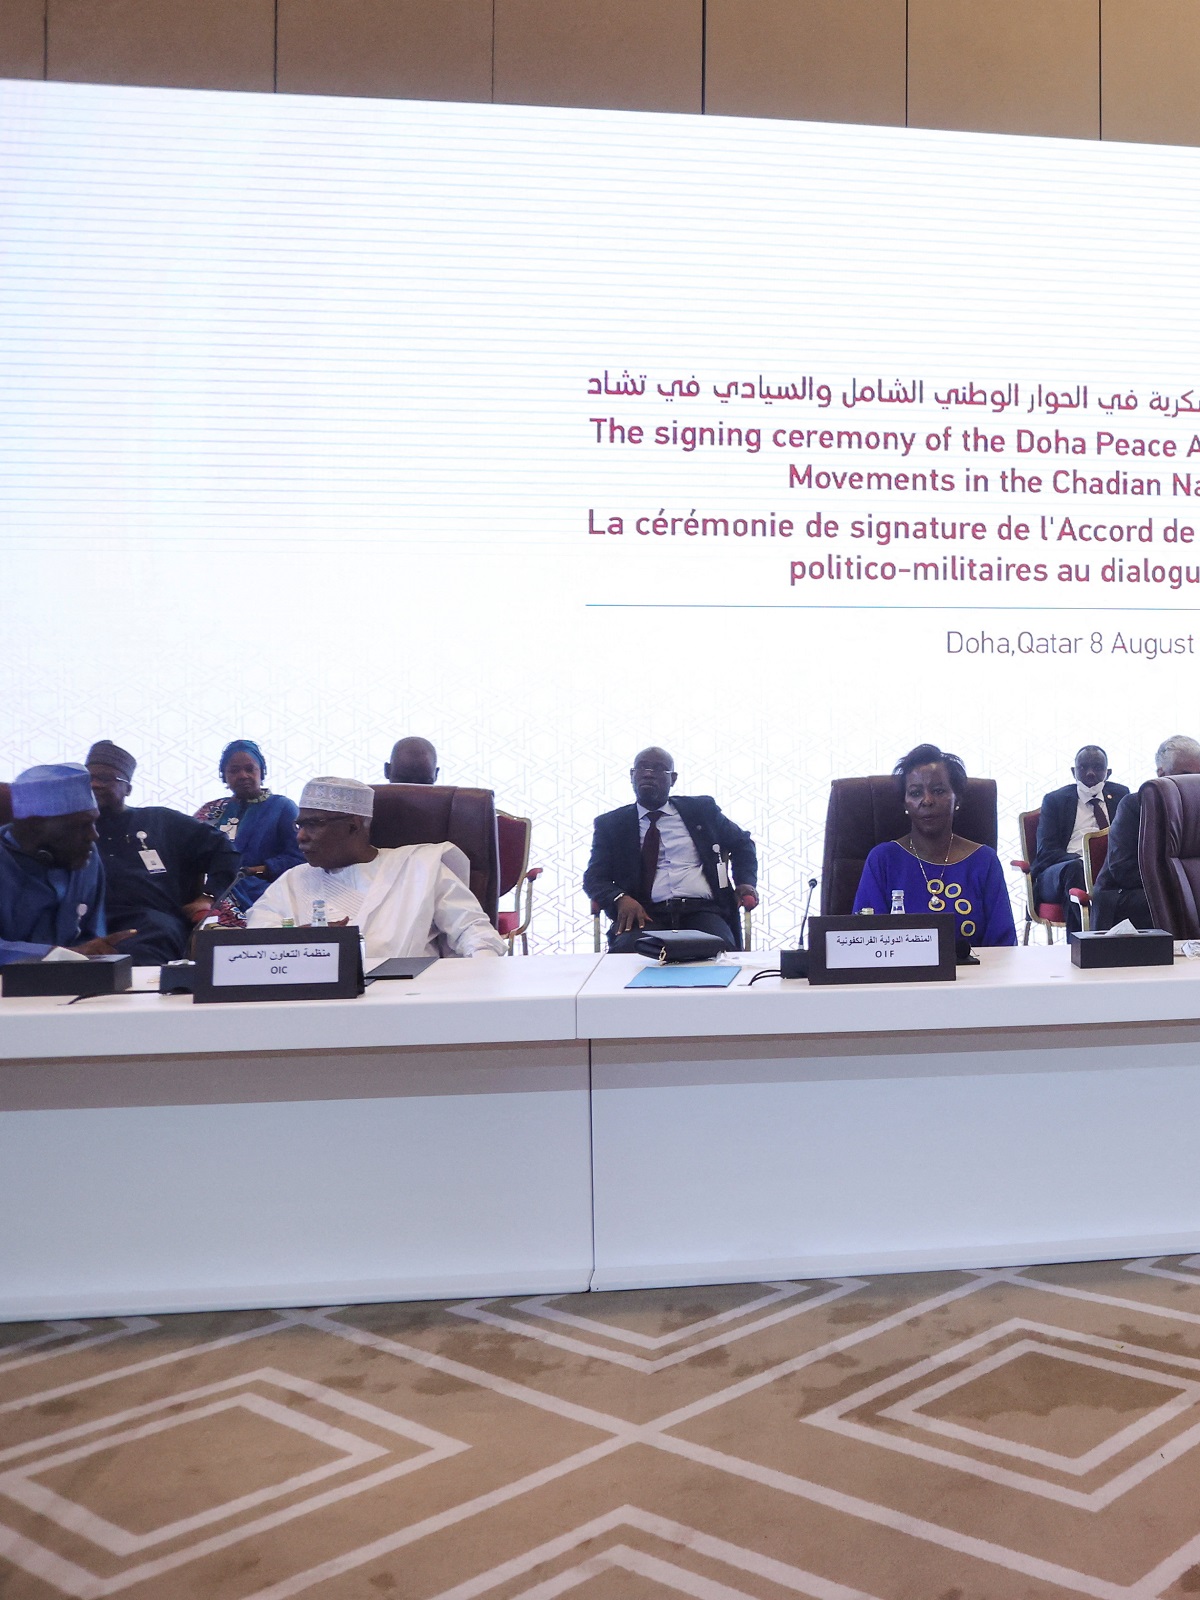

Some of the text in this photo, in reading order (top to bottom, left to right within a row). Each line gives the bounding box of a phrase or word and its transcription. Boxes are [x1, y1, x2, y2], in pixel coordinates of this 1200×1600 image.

[587, 369, 647, 396] تشاد
[657, 375, 701, 402] في
[713, 374, 832, 408] والسيادي
[842, 377, 924, 409] الشامل
[934, 381, 1019, 413] الوطني
[1027, 383, 1088, 415] الحوار
[1097, 389, 1138, 415] في
[589, 417, 644, 445] The
[654, 419, 761, 454] signing
[772, 428, 916, 457] ceremony
[925, 426, 952, 452] of
[961, 426, 1006, 453] the
[1016, 429, 1087, 455] Doha
[1096, 431, 1177, 458] Peace
[789, 463, 955, 492] Movements
[965, 467, 989, 492] in
[999, 467, 1043, 494] the
[1052, 468, 1161, 496] Chadian
[588, 508, 624, 535] La
[635, 507, 794, 538] cérémonie
[806, 511, 839, 539] de
[850, 513, 987, 546] signature
[997, 514, 1030, 541] de
[1040, 515, 1153, 543] l'Accord
[1163, 518, 1195, 544] de
[790, 553, 1048, 587] politico-militaires
[1057, 563, 1090, 582] au
[1090, 631, 1103, 654] 8
[1110, 631, 1195, 660] August
[269, 950, 300, 961] التعاون
[303, 948, 331, 958] منظمة
[270, 966, 288, 975] OIC
